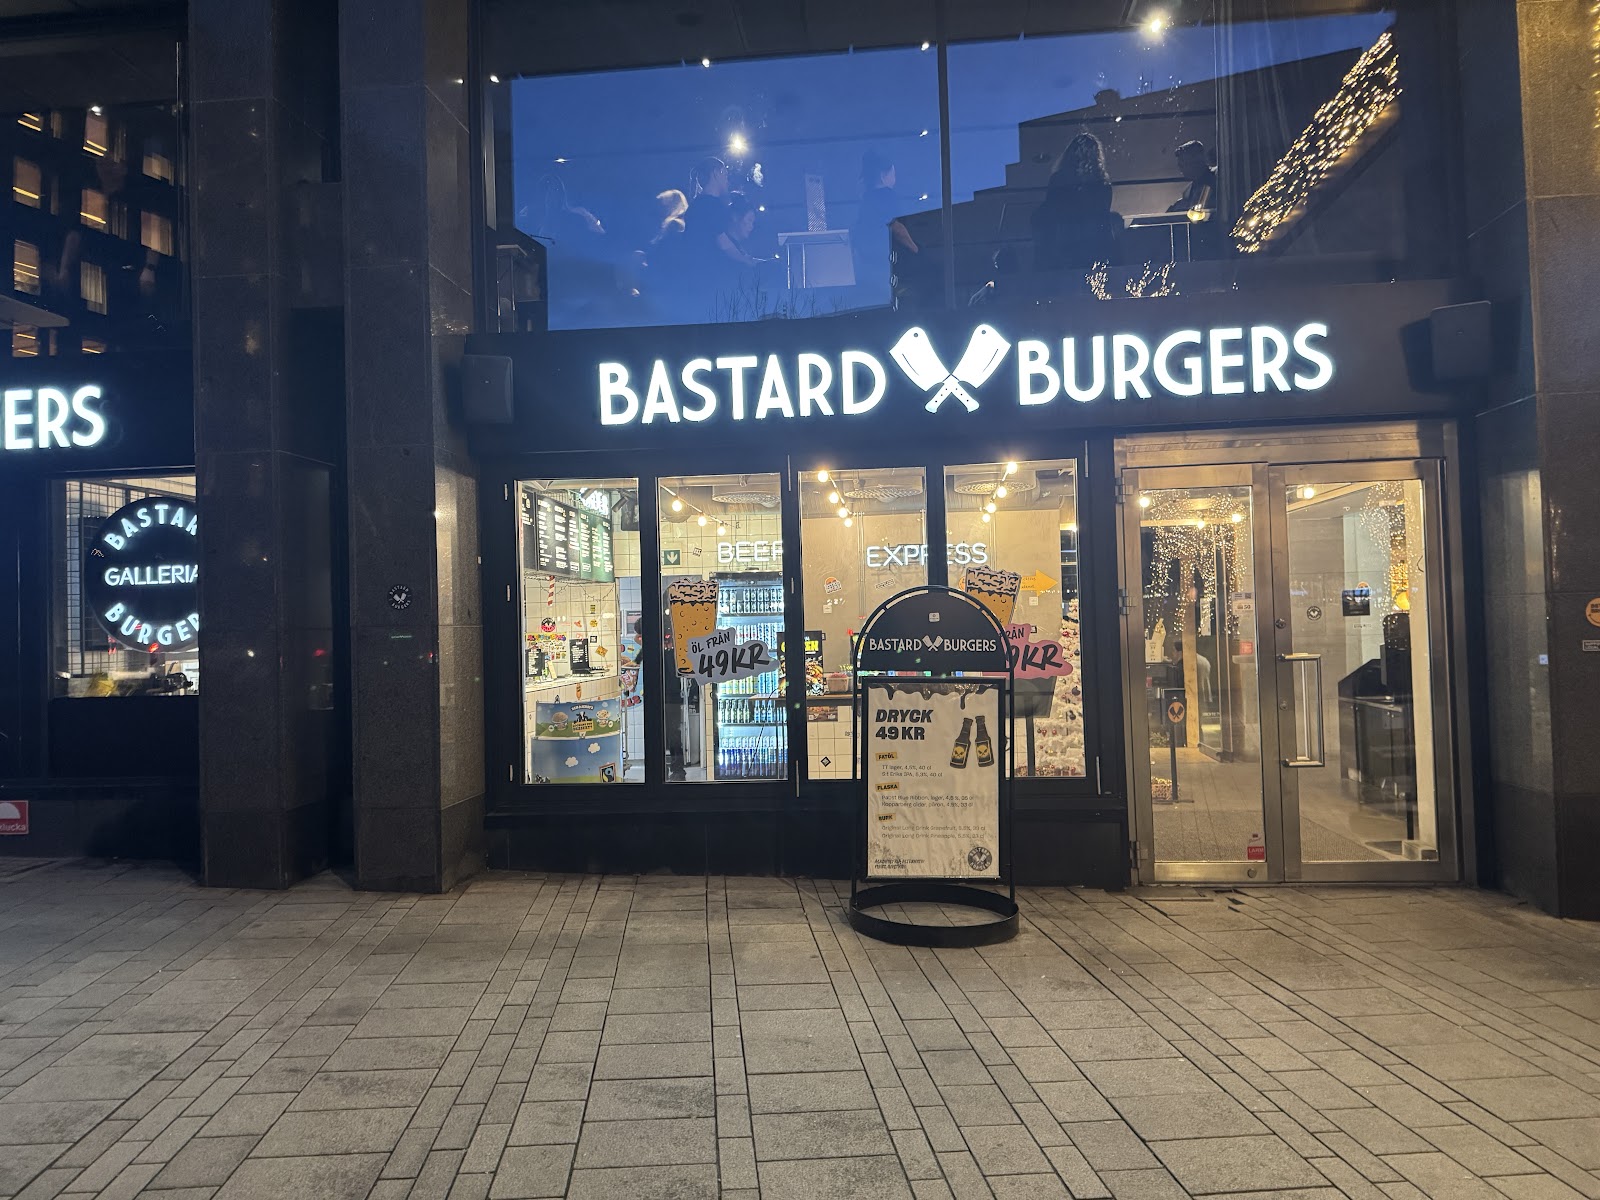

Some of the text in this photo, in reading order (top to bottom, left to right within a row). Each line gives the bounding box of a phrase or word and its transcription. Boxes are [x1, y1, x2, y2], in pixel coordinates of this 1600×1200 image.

[598, 322, 1333, 426] BASTARD BURGERS
[691, 631, 731, 654] ÖL FRÅN
[869, 638, 997, 652] BASTARD BURGERS
[875, 709, 934, 723] DRYCK
[875, 726, 925, 740] 49 KR
